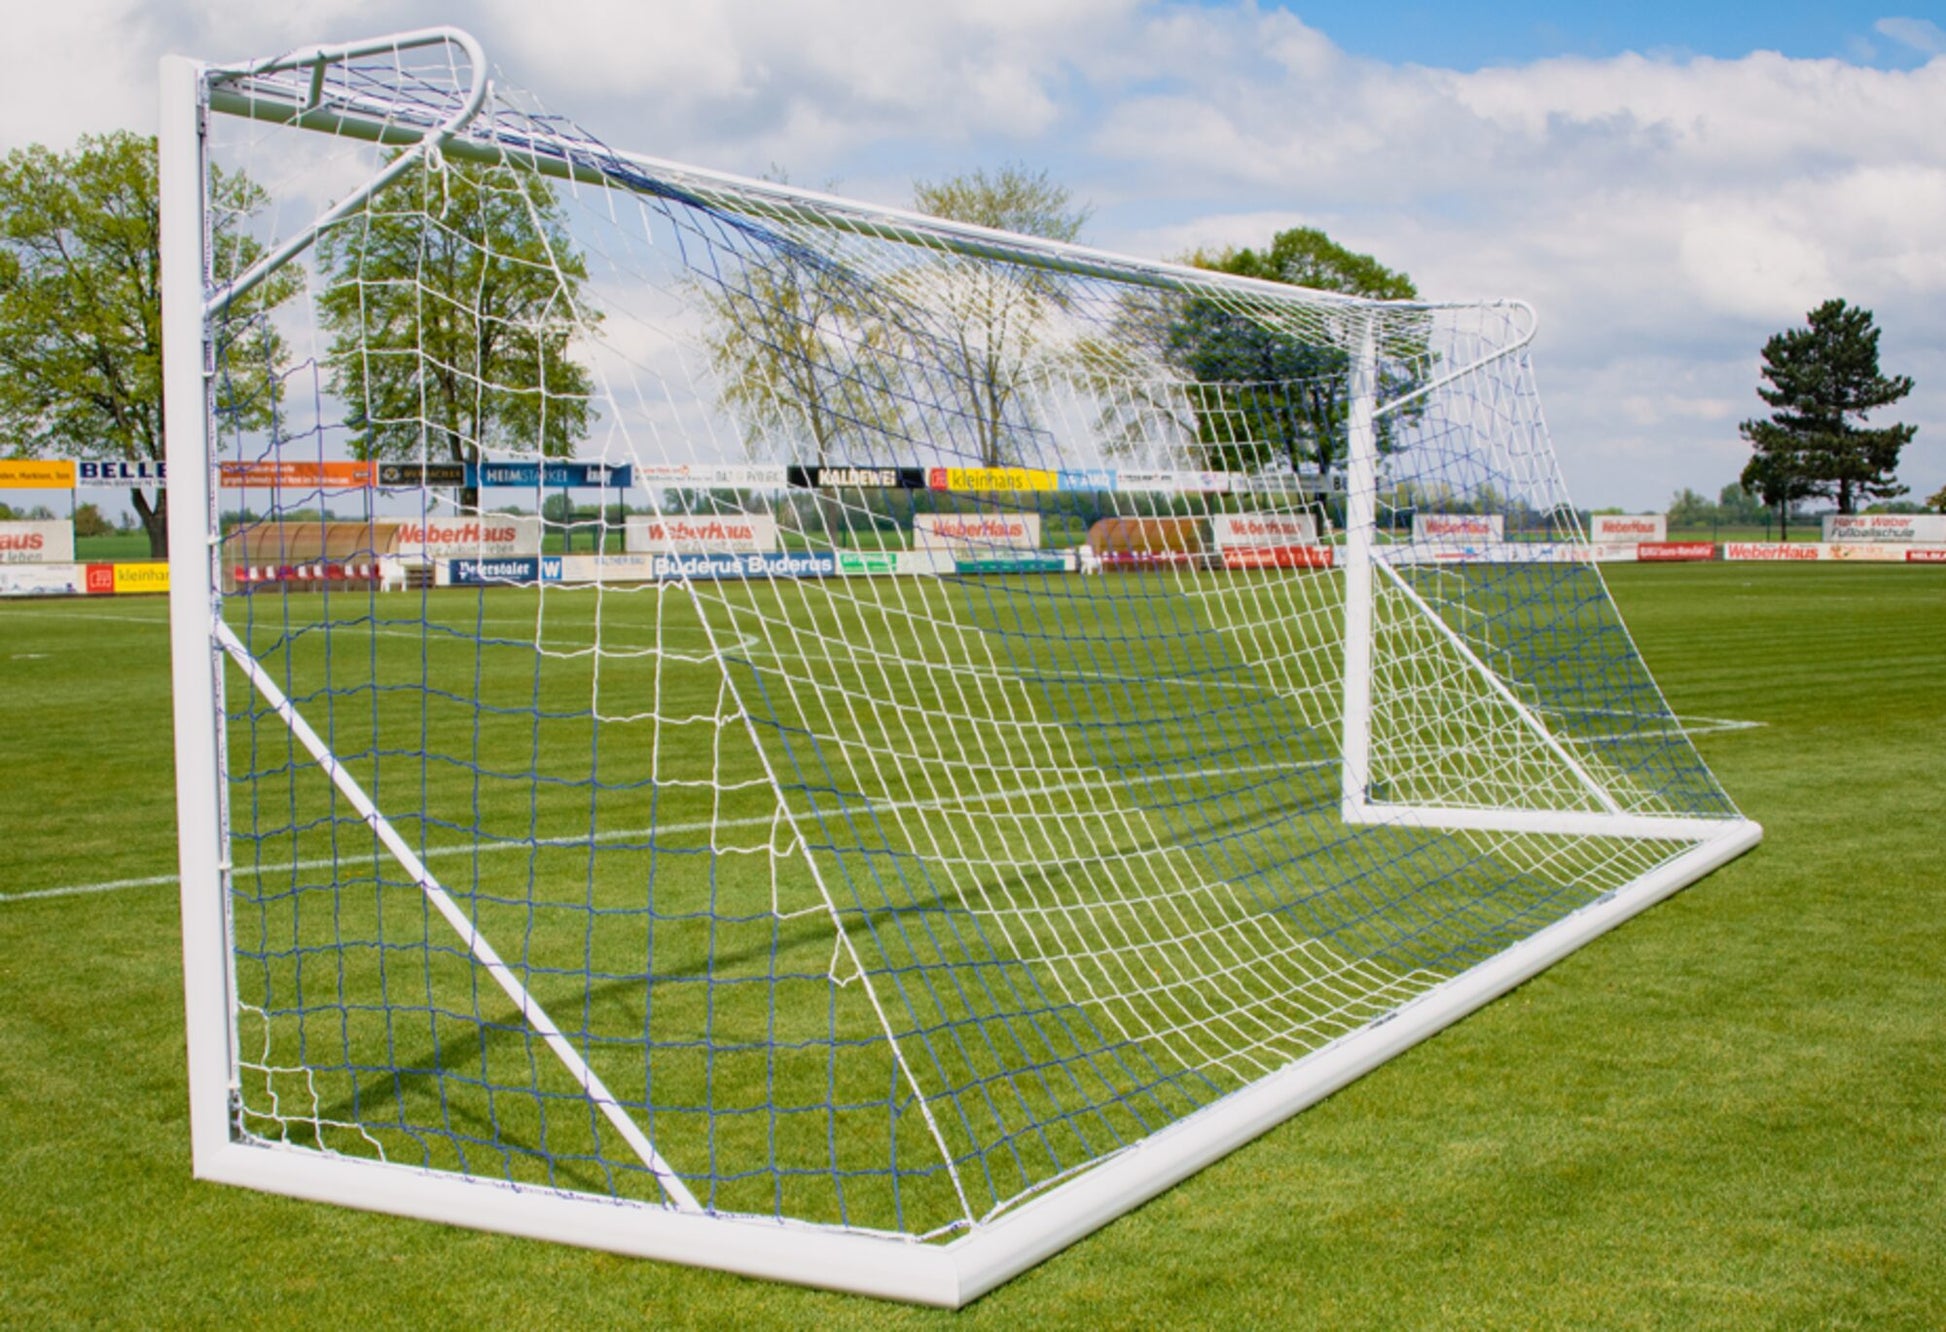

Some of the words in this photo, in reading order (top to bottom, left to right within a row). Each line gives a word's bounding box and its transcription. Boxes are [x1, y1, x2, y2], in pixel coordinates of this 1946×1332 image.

[818, 468, 897, 486] KALDEWEI
[953, 469, 1023, 489] kleinhans
[933, 520, 1023, 537] WeberHaus
[1602, 521, 1656, 533] WeberHaus
[1832, 517, 1866, 527] Hans
[1871, 517, 1912, 527] Weber
[397, 523, 516, 543] WeberHaus
[648, 522, 753, 540] WeberHaus
[1728, 543, 1819, 560] WeberHaus
[543, 561, 560, 578] W
[655, 556, 742, 575] Buderus
[748, 555, 833, 573] Buderus
